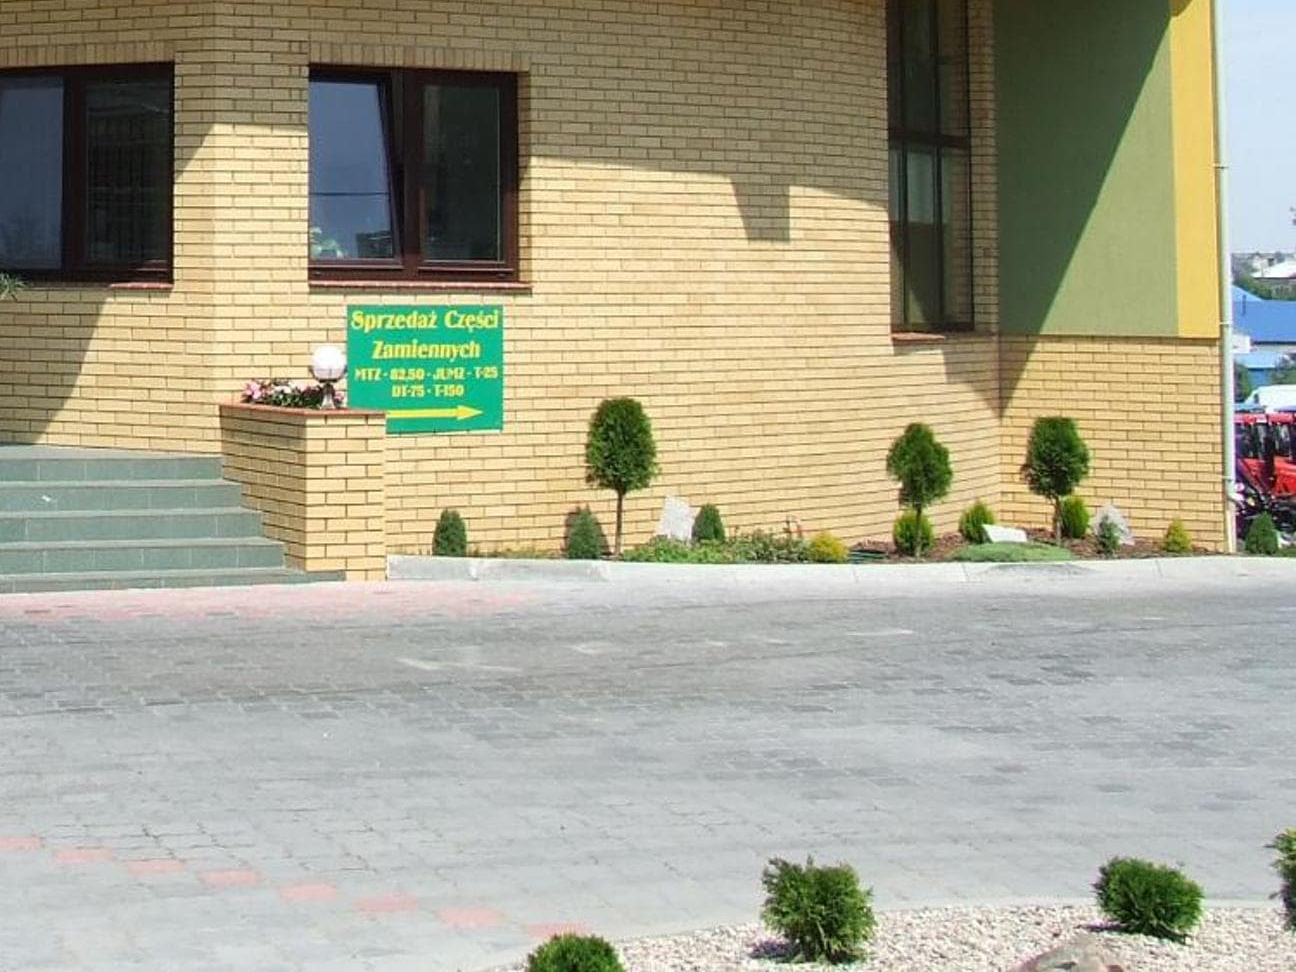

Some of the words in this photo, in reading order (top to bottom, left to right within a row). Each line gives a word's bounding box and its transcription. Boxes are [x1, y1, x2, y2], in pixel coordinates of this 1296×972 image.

[351, 310, 438, 333] Sprzedaż
[444, 310, 499, 333] Części
[372, 338, 481, 362] Zamiennych
[355, 368, 382, 381] MTZ
